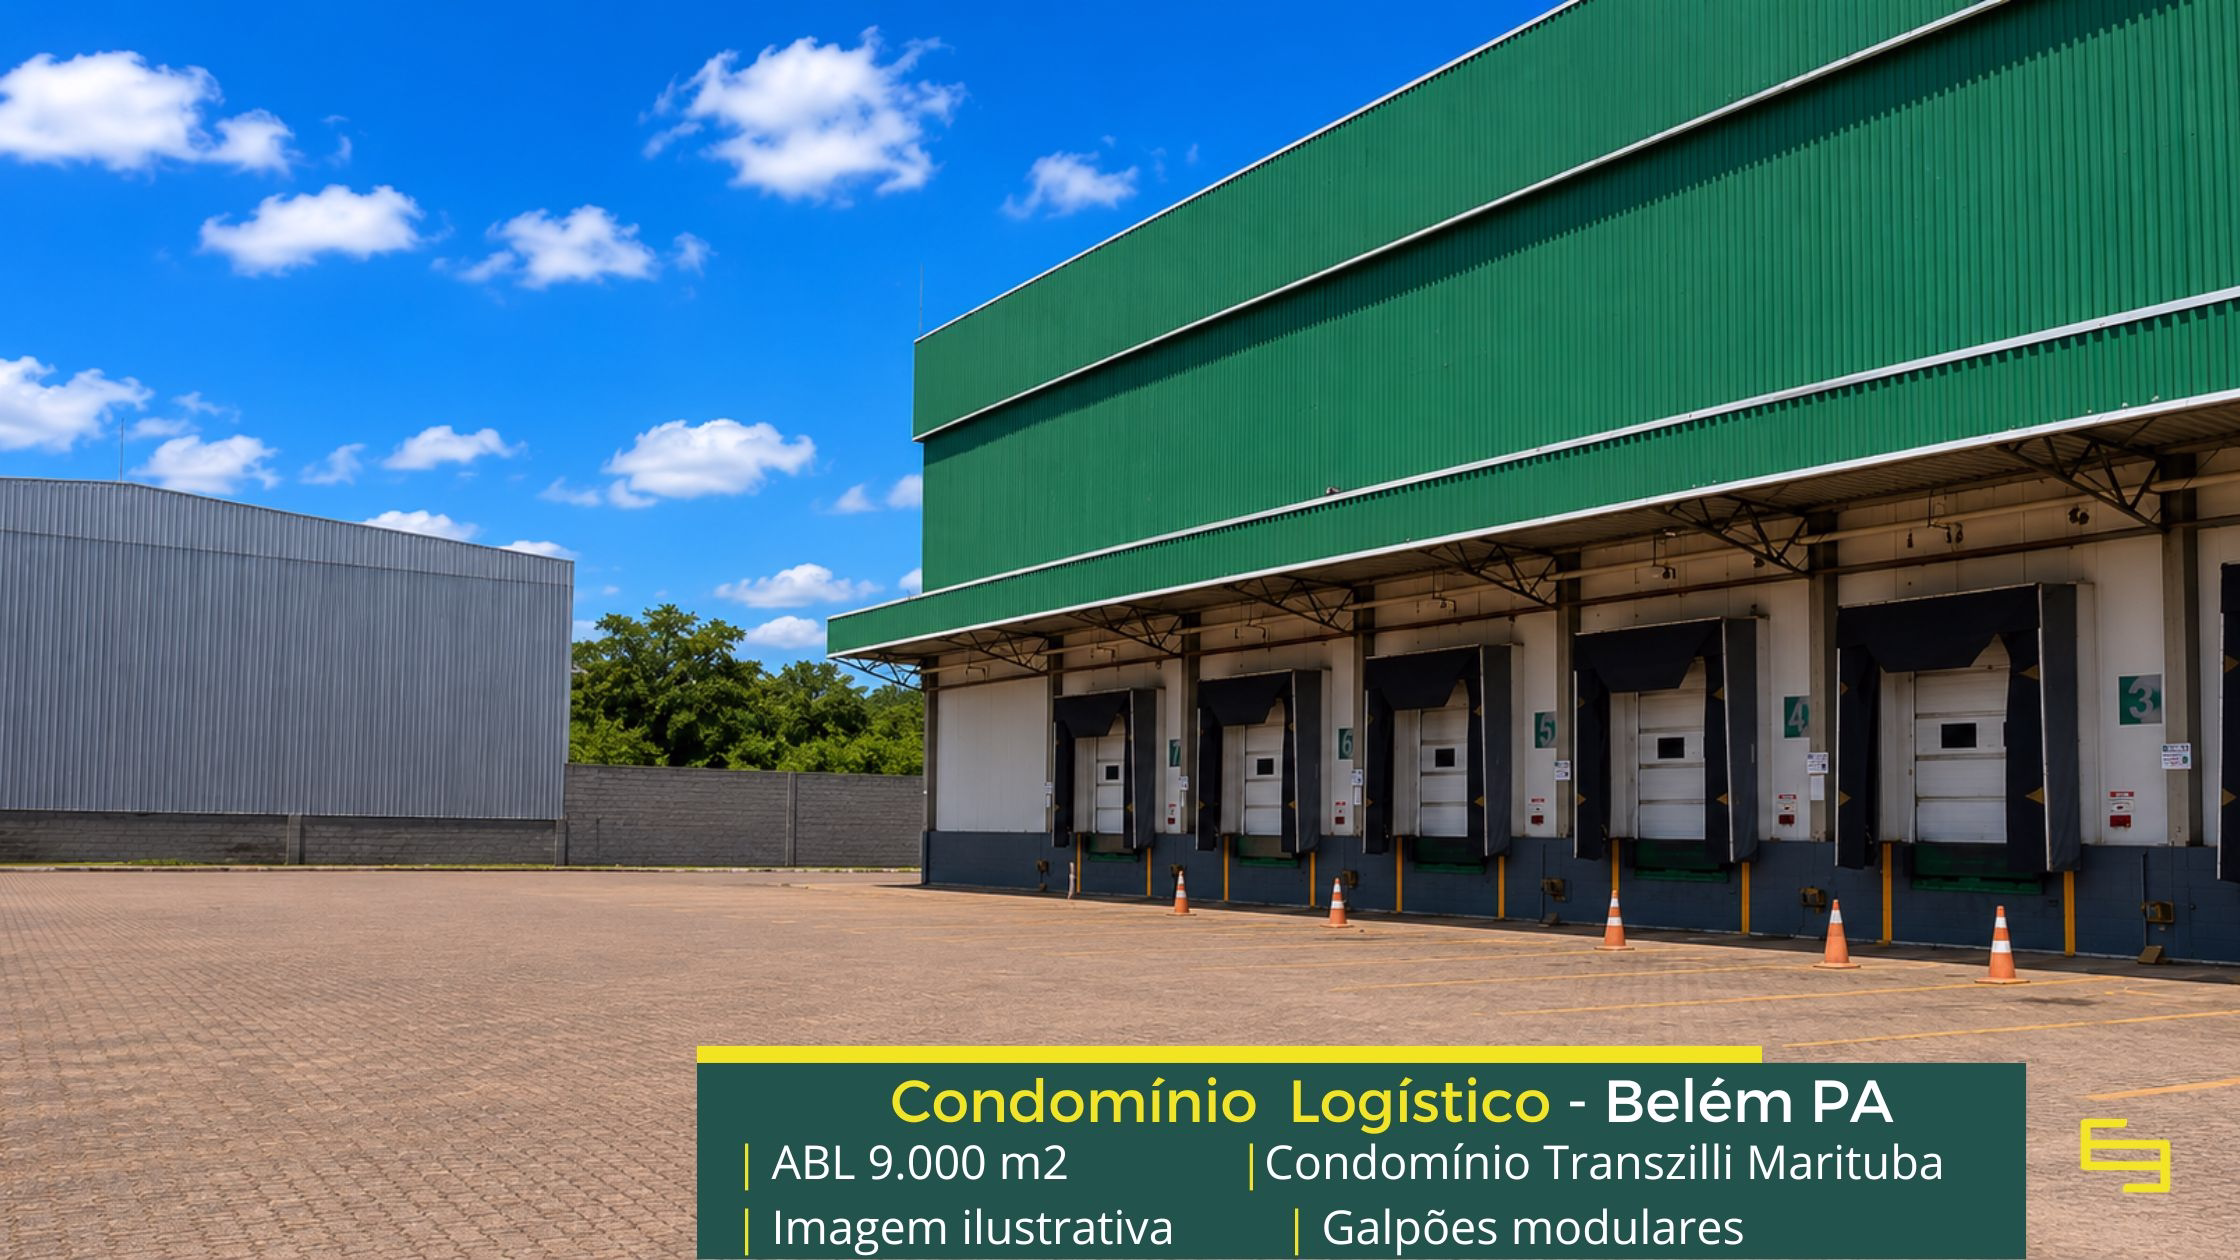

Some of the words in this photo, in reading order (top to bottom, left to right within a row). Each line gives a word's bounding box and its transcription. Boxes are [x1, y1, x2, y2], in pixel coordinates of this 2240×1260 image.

[2128, 675, 2154, 719] 3
[1540, 713, 1554, 745] 5
[1788, 697, 1805, 733] 4
[1342, 729, 1353, 757] 6
